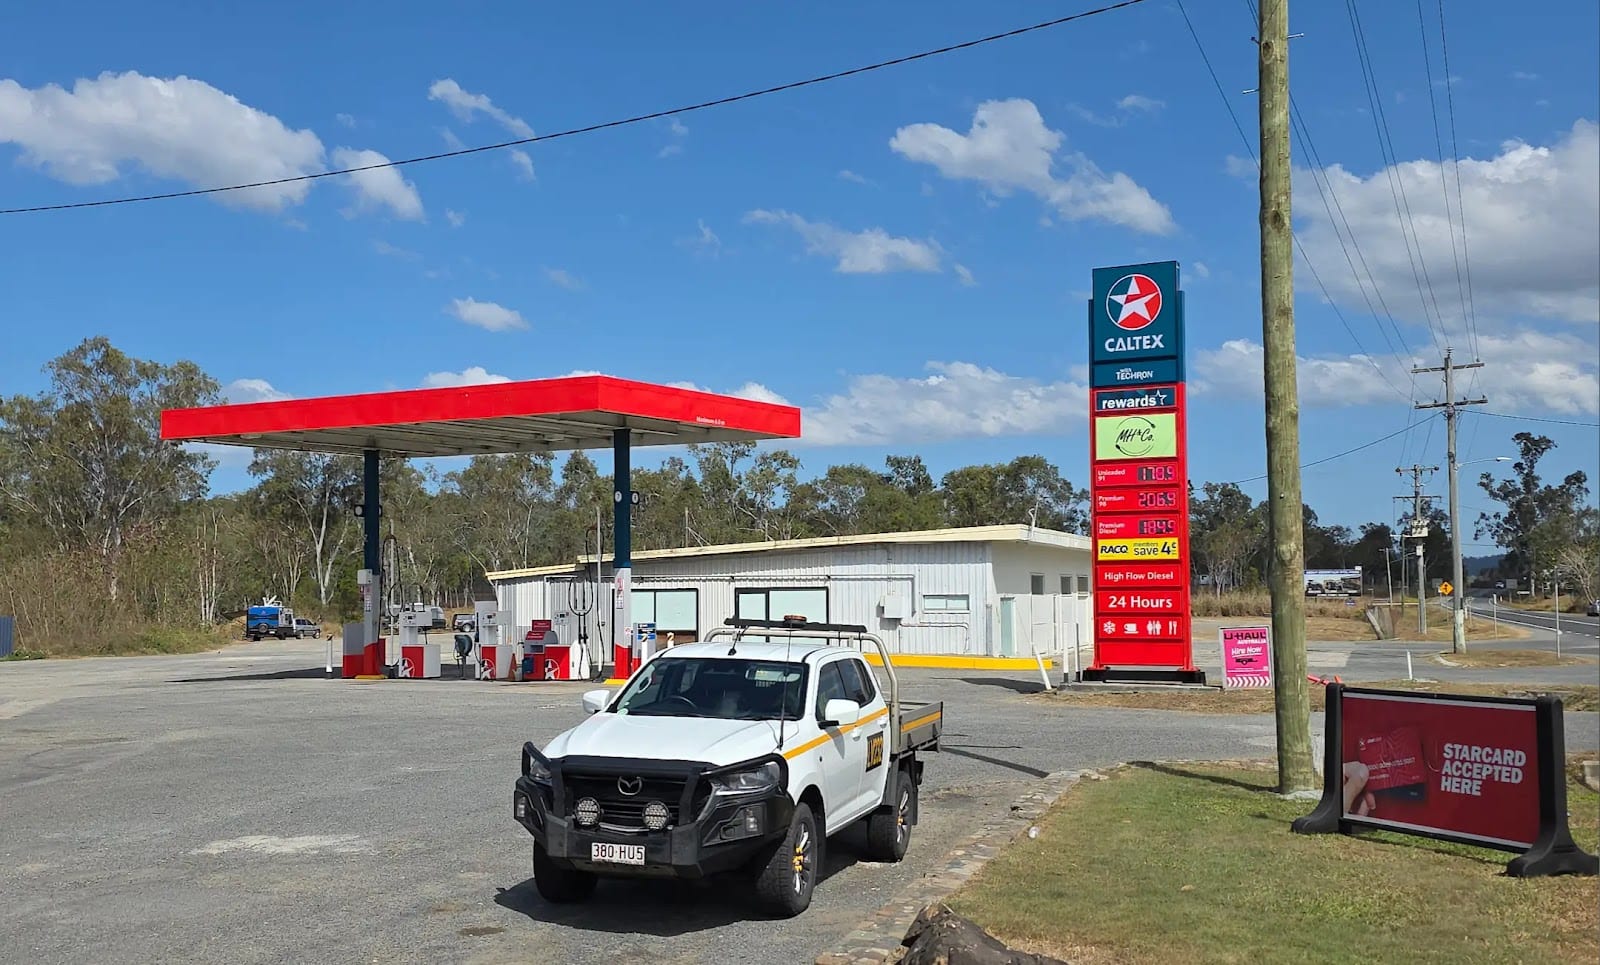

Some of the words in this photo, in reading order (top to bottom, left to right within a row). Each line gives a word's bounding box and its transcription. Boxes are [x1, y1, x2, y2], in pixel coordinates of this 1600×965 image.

[1104, 334, 1164, 352] CALTEX
[1116, 370, 1154, 380] TECHRON
[1102, 395, 1156, 409] rewards
[1138, 492, 1176, 507] 206.9
[1100, 545, 1128, 554] RACQ
[1134, 547, 1158, 556] save
[1104, 572, 1124, 582] High
[1126, 572, 1145, 580] Flow
[1148, 570, 1174, 580] Diesel
[1108, 596, 1126, 608] 24
[1130, 596, 1172, 608] Hours
[1224, 632, 1266, 640] U-HAUL
[1232, 648, 1246, 656] Hire
[1442, 743, 1526, 767] STARCARD
[1442, 762, 1524, 784] ACCEPTED
[1440, 776, 1482, 796] HERE
[593, 844, 614, 858] 380
